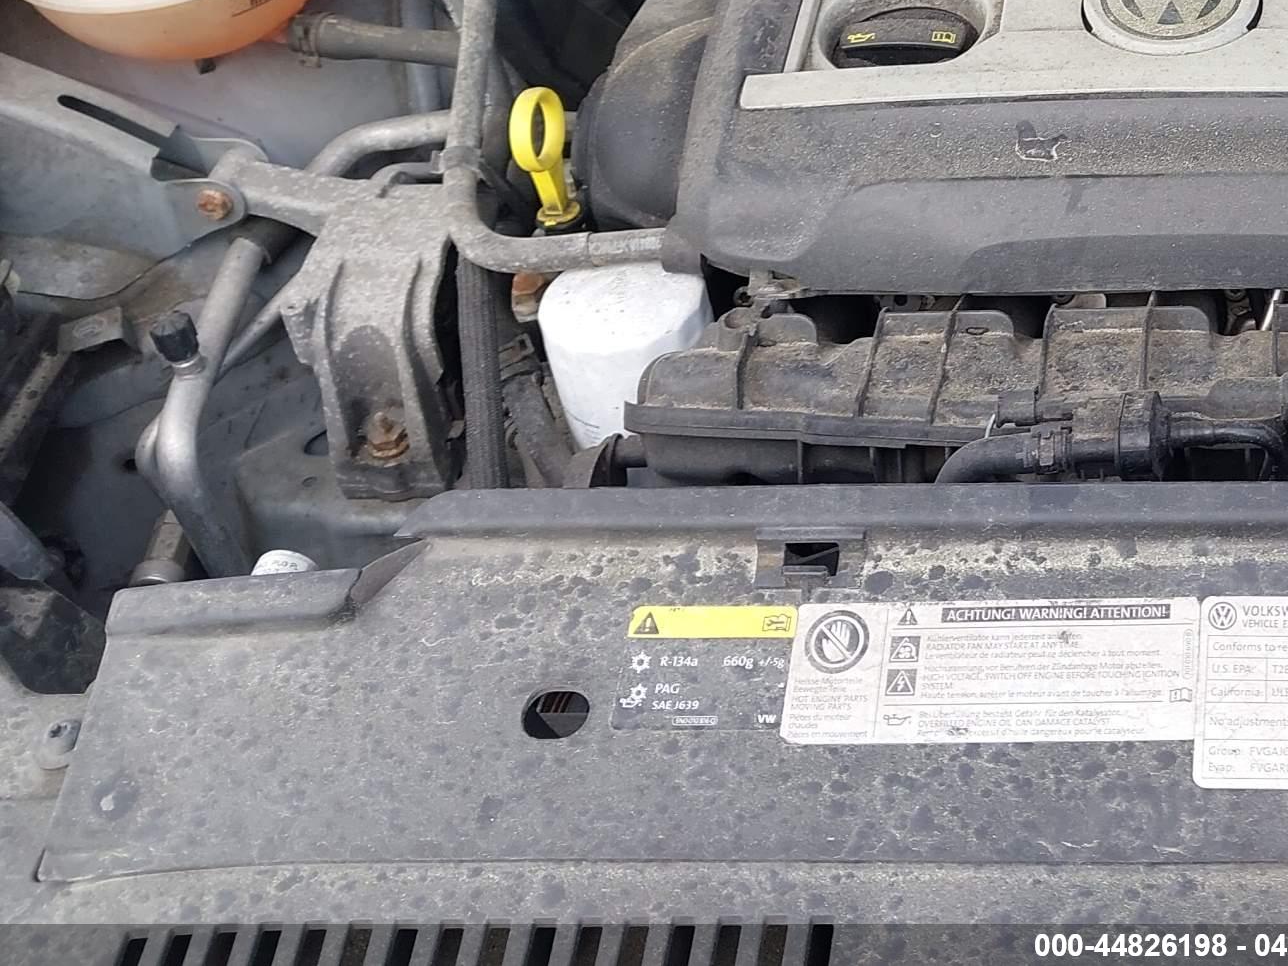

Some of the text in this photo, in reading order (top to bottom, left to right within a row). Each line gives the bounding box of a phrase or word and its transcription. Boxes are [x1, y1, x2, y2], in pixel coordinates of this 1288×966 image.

[947, 606, 1166, 621] ACHTUNG! WARNING! ATTENTION!
[1242, 619, 1278, 628] VEHICLE
[1212, 642, 1262, 651] Conforms
[1264, 643, 1277, 652] to
[660, 656, 698, 667] R-134a
[723, 656, 785, 670] 660g +/-5g
[654, 684, 681, 694] PAG
[651, 700, 700, 710] SAE J639
[757, 714, 777, 724] VW
[1210, 716, 1225, 727] No
